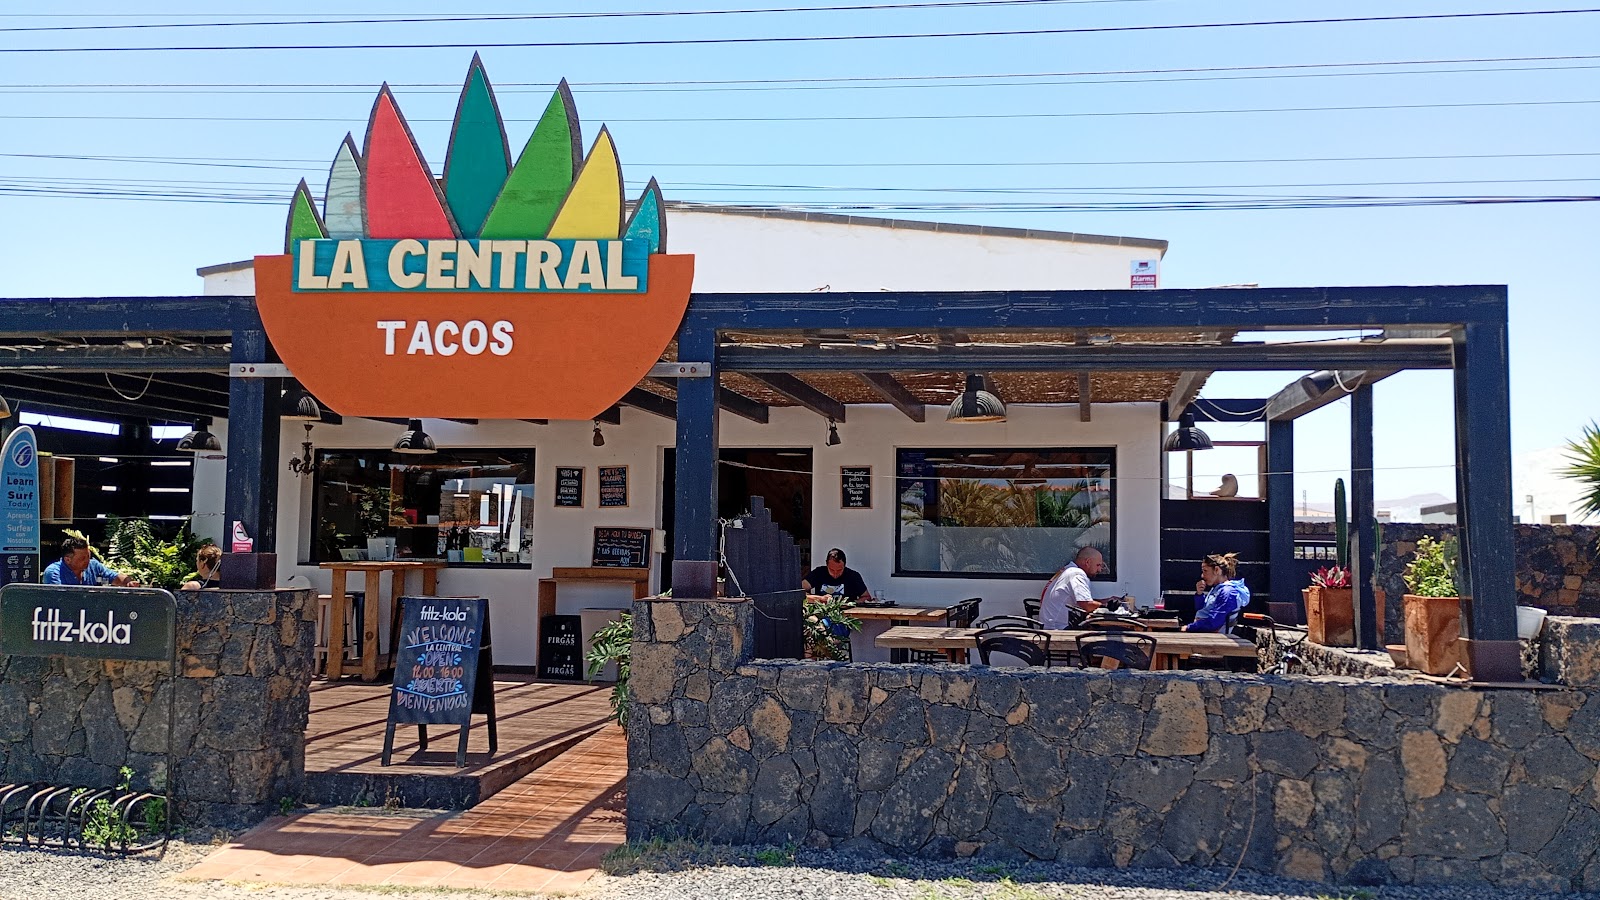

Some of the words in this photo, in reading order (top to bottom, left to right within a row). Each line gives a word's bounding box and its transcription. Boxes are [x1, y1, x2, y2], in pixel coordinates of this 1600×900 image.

[298, 239, 370, 290] LA
[387, 238, 638, 290] CENTRAL
[376, 319, 515, 356] TACOS
[7, 476, 34, 486] Learn
[7, 491, 34, 500] Surf
[8, 500, 33, 509] Today!
[7, 512, 33, 520] Aprende
[7, 524, 34, 532] Surfear
[407, 624, 476, 646] WELCOME
[547, 636, 576, 644] FIRGAS
[425, 644, 435, 652] LA
[436, 644, 463, 653] CENTRAL
[425, 651, 454, 667] OPEN
[546, 666, 575, 675] FIRGAS
[412, 677, 457, 693] ABIERTO
[396, 691, 468, 714] BIENVENIDOS
